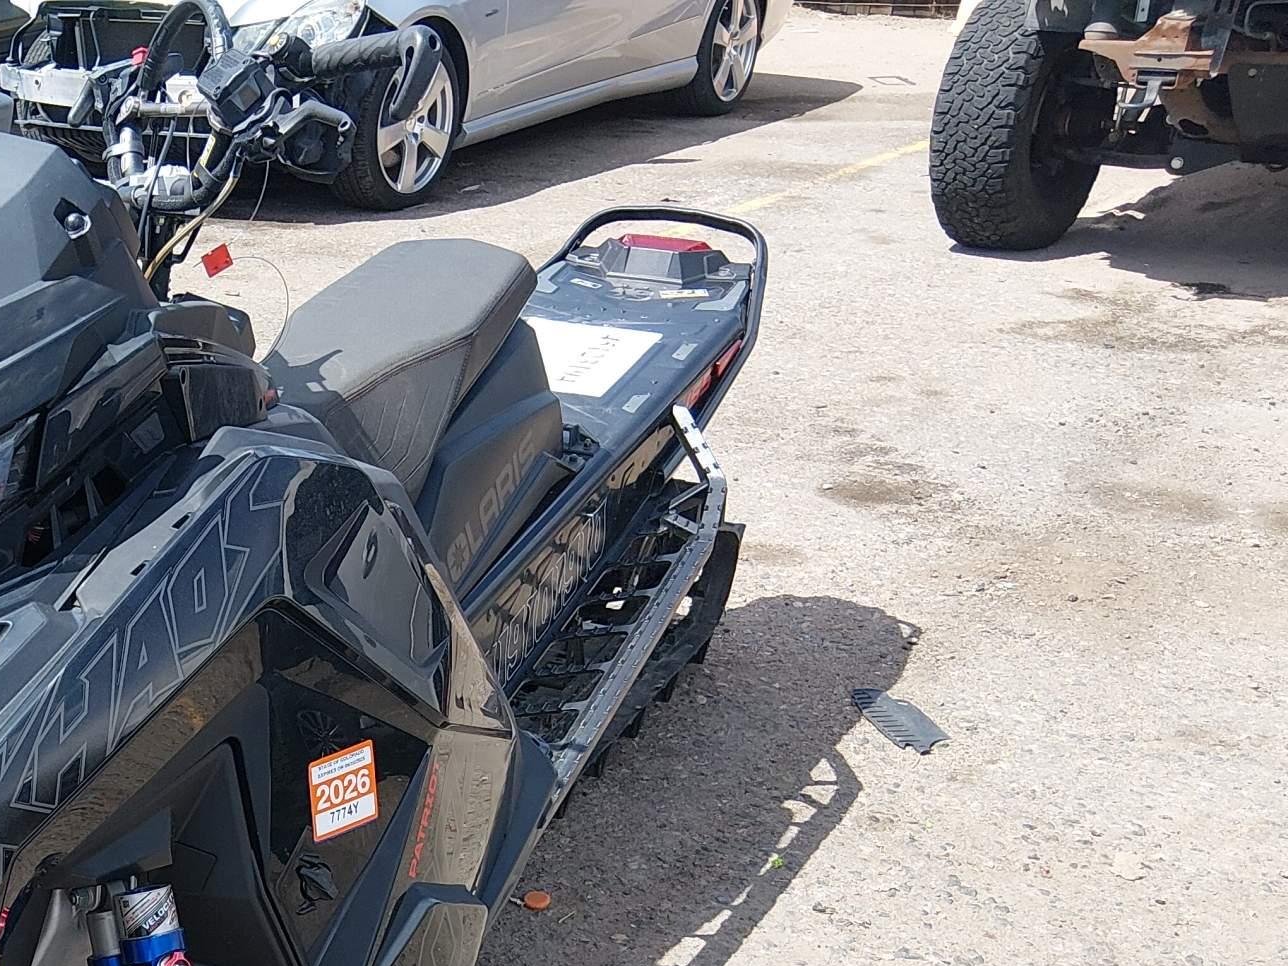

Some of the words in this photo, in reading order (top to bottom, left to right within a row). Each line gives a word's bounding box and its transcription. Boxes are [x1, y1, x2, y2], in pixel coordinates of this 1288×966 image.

[446, 429, 536, 583] OLARIS
[316, 768, 371, 811] 2026
[330, 801, 360, 824] 7774Y
[408, 760, 441, 879] PATRIOT
